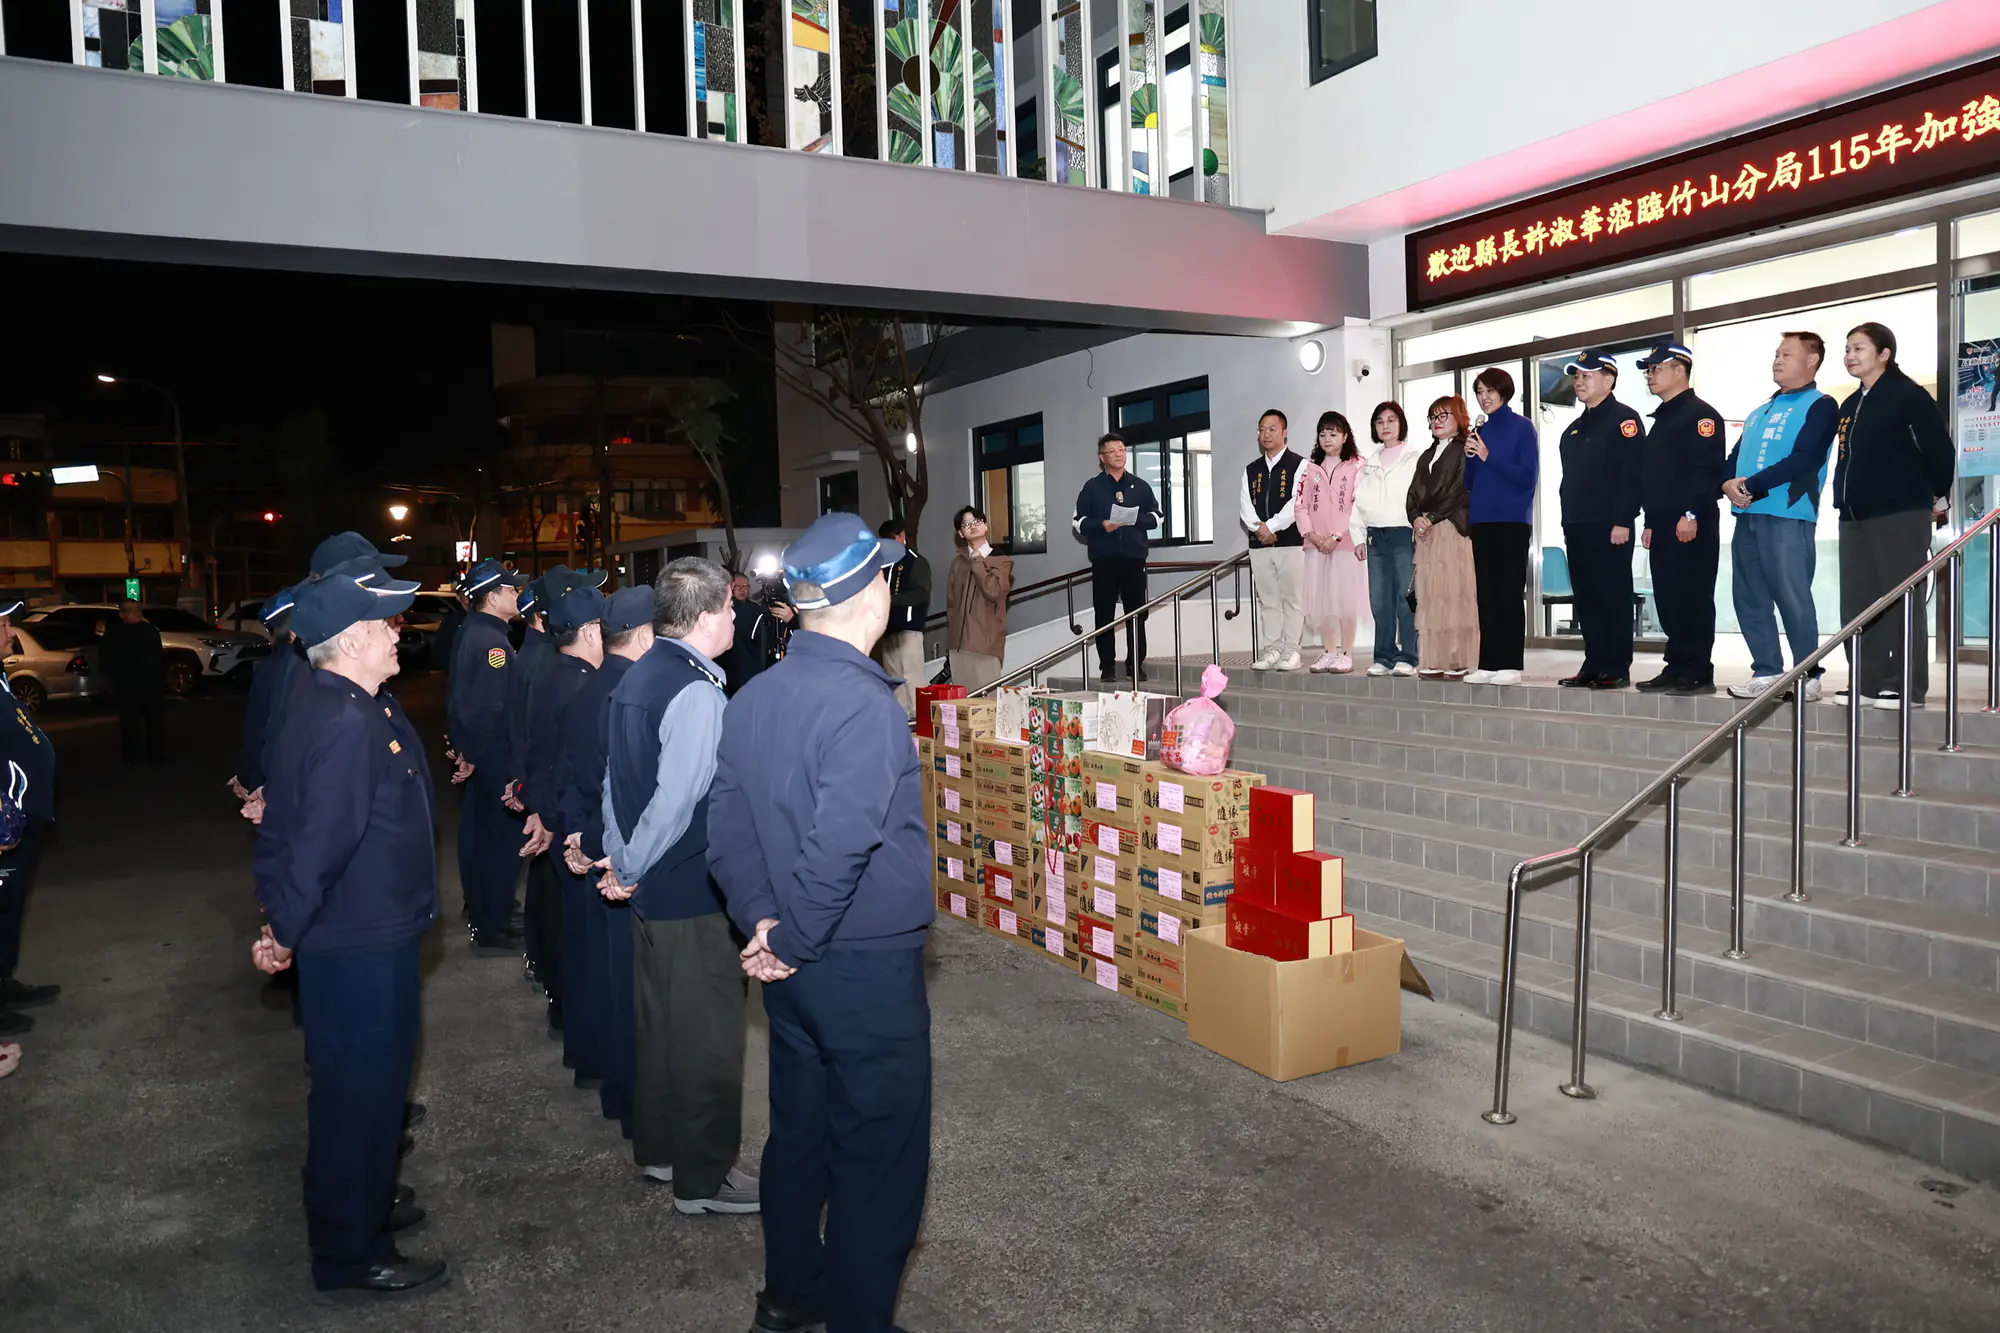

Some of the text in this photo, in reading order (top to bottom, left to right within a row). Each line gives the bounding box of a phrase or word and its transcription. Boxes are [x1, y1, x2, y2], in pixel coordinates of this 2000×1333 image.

[1426, 95, 2000, 282] 歡迎縣長許淑華蒞臨竹山分局115年加強
[1217, 805, 1240, 820] 隨緣
[1213, 848, 1235, 864] 隨緣
